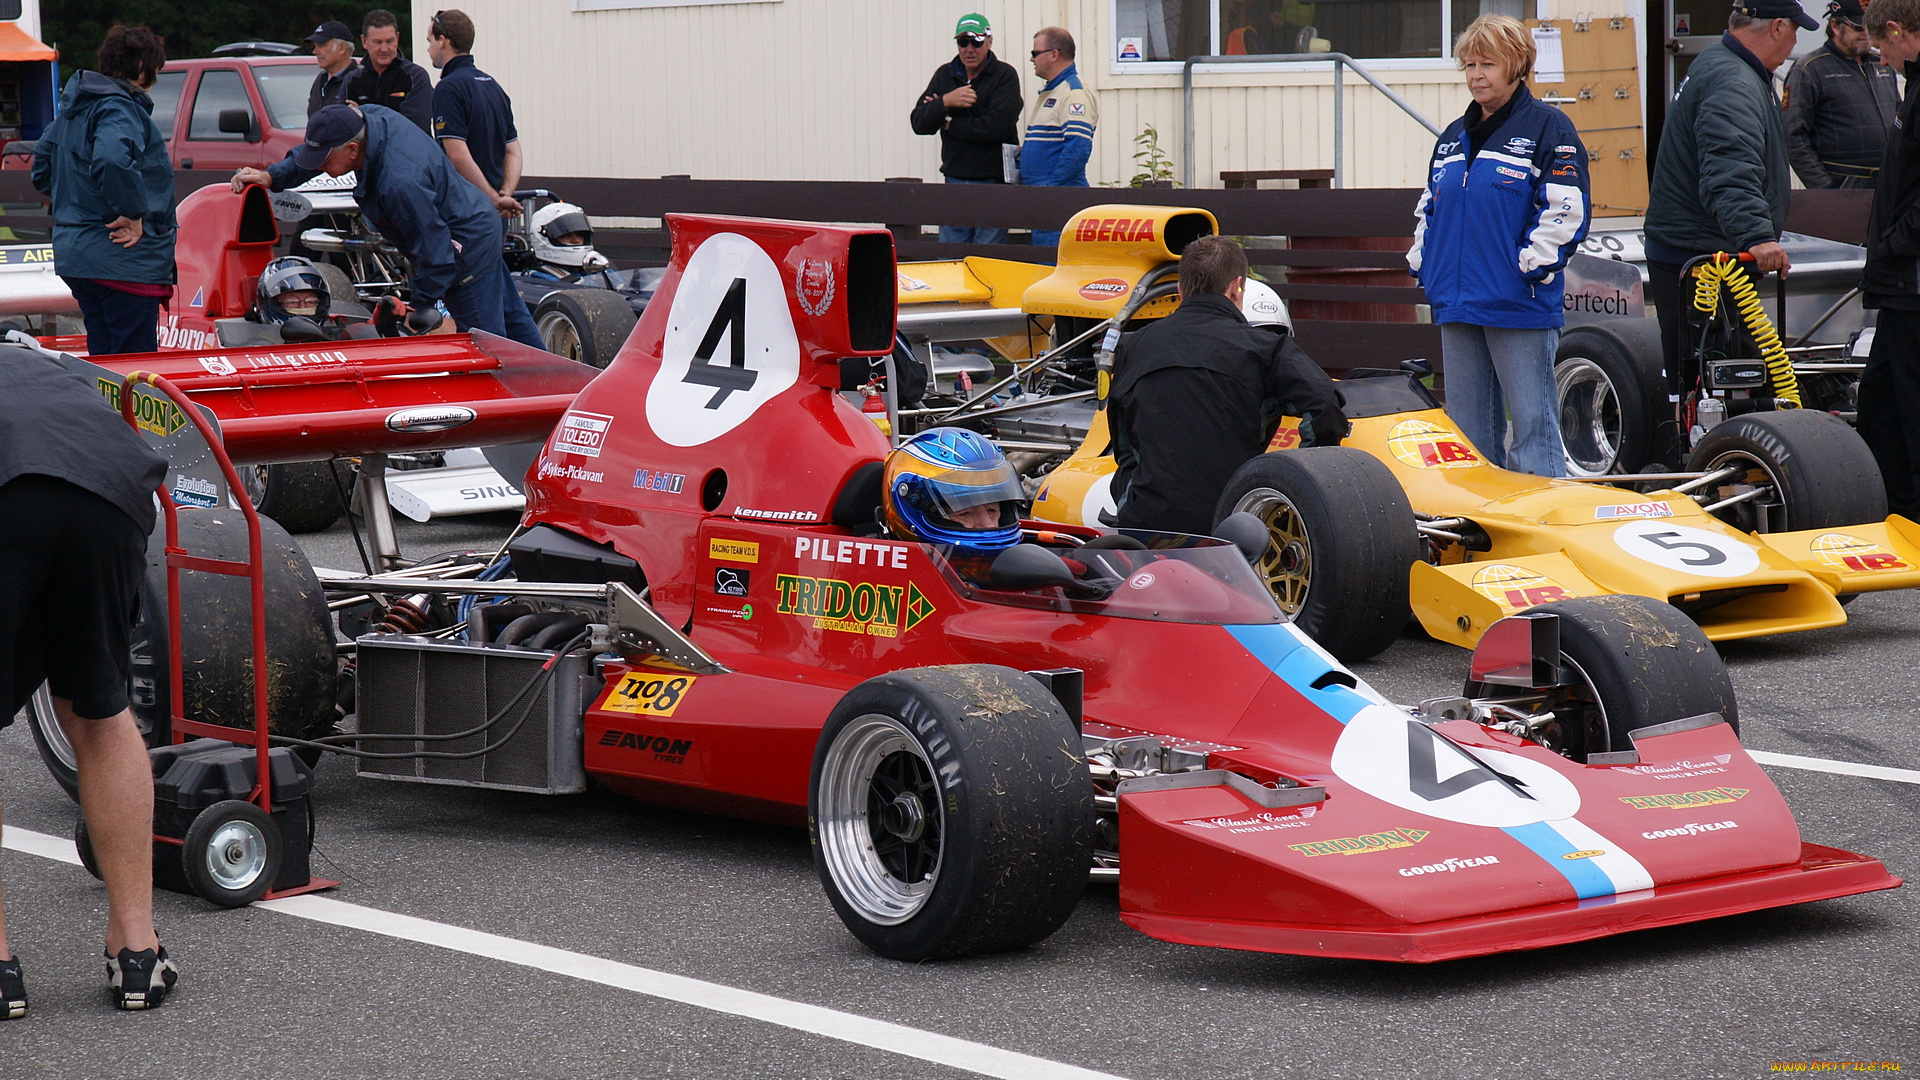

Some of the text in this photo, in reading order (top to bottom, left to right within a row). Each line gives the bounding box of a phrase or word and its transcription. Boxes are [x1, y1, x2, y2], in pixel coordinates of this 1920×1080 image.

[1491, 182, 1523, 196] NOVOTEL
[279, 200, 302, 210] AVON
[1075, 218, 1155, 242] IBERIA
[1256, 302, 1276, 311] Arai
[681, 277, 758, 410] 4
[97, 377, 168, 429] TRDON
[408, 412, 462, 423] Flamecrusher
[574, 419, 594, 429] FAMOUS
[562, 428, 600, 446] TOLEDO
[1740, 424, 1790, 465] AVON
[1418, 442, 1478, 467] IB
[546, 460, 604, 483] Sykes-Pickavant
[633, 469, 671, 492] Mobil
[176, 474, 217, 497] Evolution
[175, 491, 211, 507] Motorsport
[1616, 502, 1669, 515] AVON
[733, 506, 818, 521] kensmith
[1642, 510, 1673, 518] TYRES
[711, 543, 729, 554] RACING
[730, 545, 743, 555] TEAM
[795, 537, 908, 569] PILETTE
[1638, 531, 1727, 566] 5
[1842, 553, 1908, 572] IB
[1135, 575, 1149, 586] E
[776, 573, 904, 627] TRIDON
[1504, 585, 1572, 608] IB
[813, 618, 898, 638] AUSTRALIAN OWNED
[618, 677, 688, 711] no.8
[618, 732, 692, 757] AVON
[901, 696, 962, 790] AVON
[654, 754, 685, 765] TYRES
[1407, 720, 1537, 802] 4
[1636, 760, 1717, 775] Classic Cover
[1654, 767, 1728, 781] INSURANCE
[1618, 789, 1731, 810] TRIDON
[1211, 812, 1301, 827] Classic Cover
[1229, 821, 1311, 834] INSURANCE
[1641, 820, 1739, 839] GOODYEAR
[1287, 830, 1404, 858] TRIDON
[1399, 855, 1501, 877] GOODYEAR
